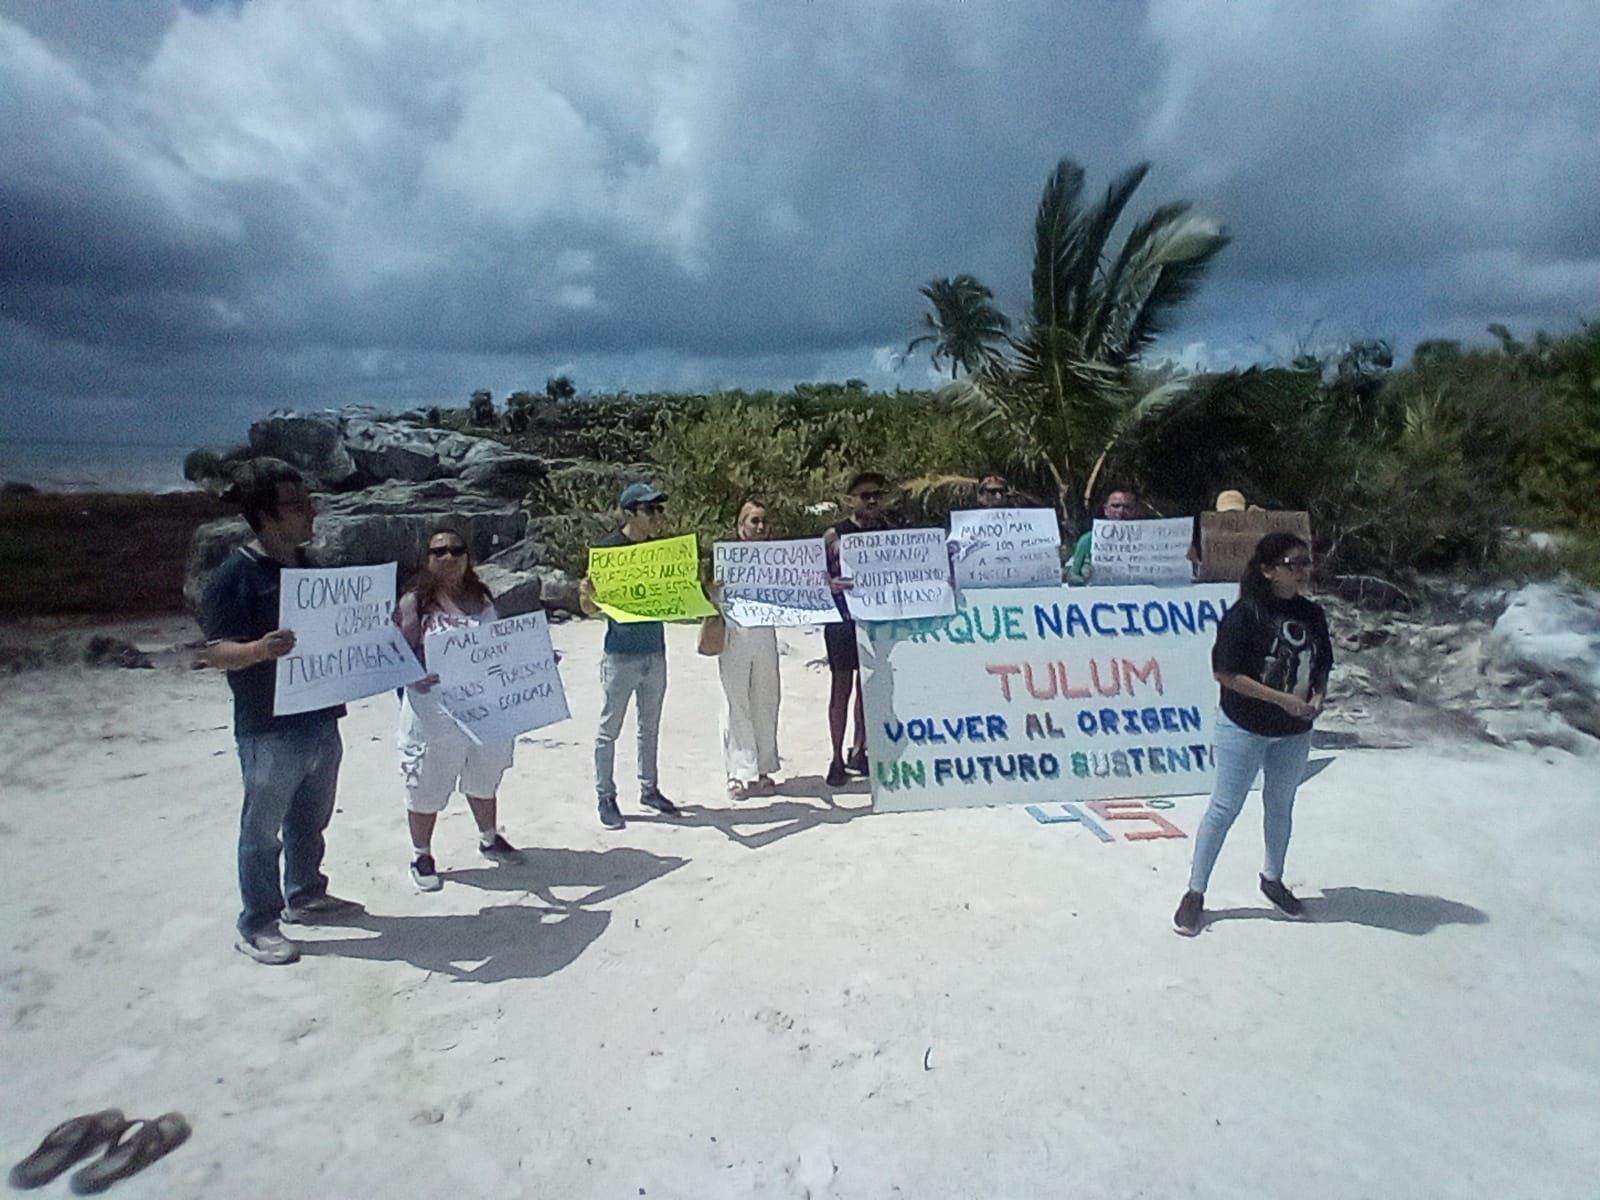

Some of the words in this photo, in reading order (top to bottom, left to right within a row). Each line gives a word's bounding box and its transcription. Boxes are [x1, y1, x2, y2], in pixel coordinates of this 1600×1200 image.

[297, 575, 374, 610] CONANP
[443, 633, 480, 656] MAL
[985, 656, 1164, 702] TULUM
[883, 713, 1008, 745] VOLVER
[1024, 711, 1066, 742] AL
[1077, 704, 1202, 738] ORIGEN
[876, 758, 927, 792] UN
[934, 751, 1060, 787] FUTURO
